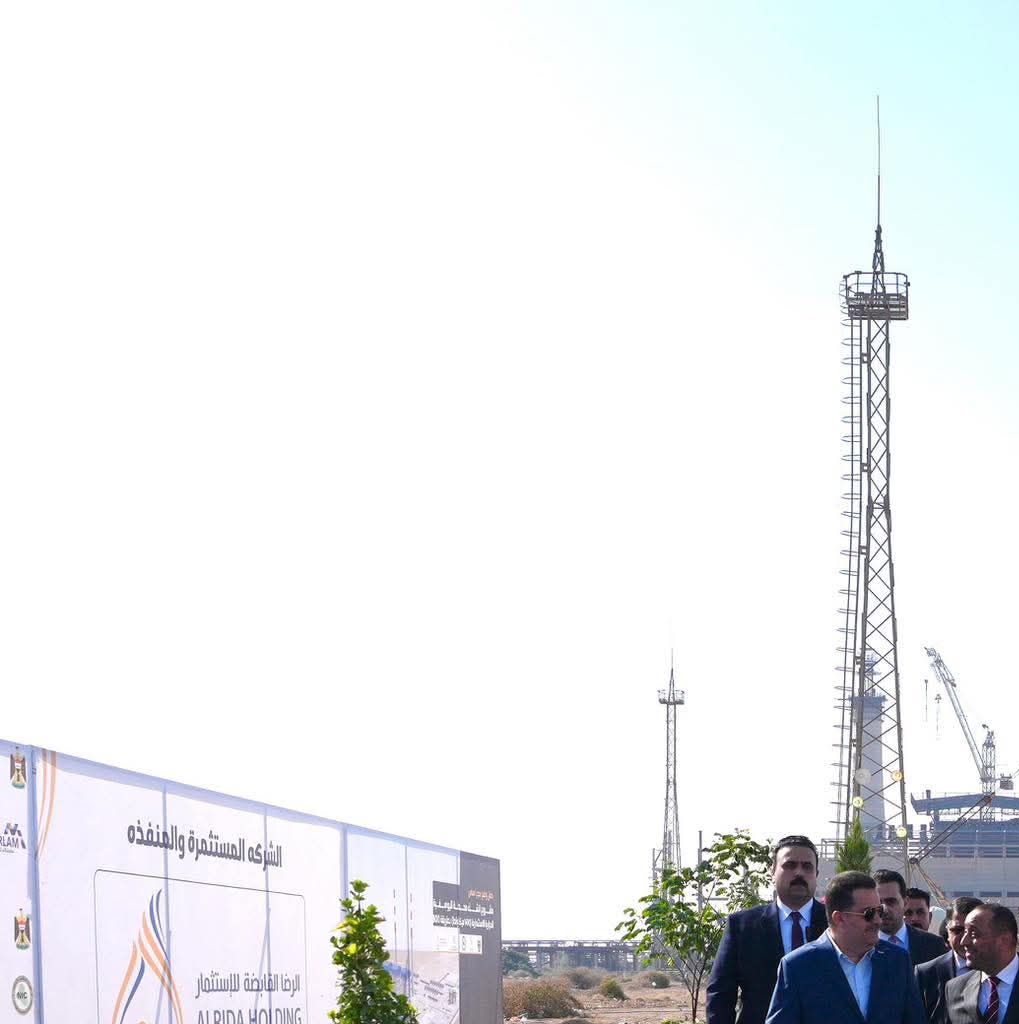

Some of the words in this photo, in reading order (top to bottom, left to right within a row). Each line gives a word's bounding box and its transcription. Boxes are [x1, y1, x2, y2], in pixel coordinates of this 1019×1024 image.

[127, 819, 185, 860] والمنفذه
[187, 829, 245, 862] المستثمرة
[247, 840, 282, 872] الشركه
[243, 972, 279, 998] القابضة
[280, 973, 301, 998] الرضا
